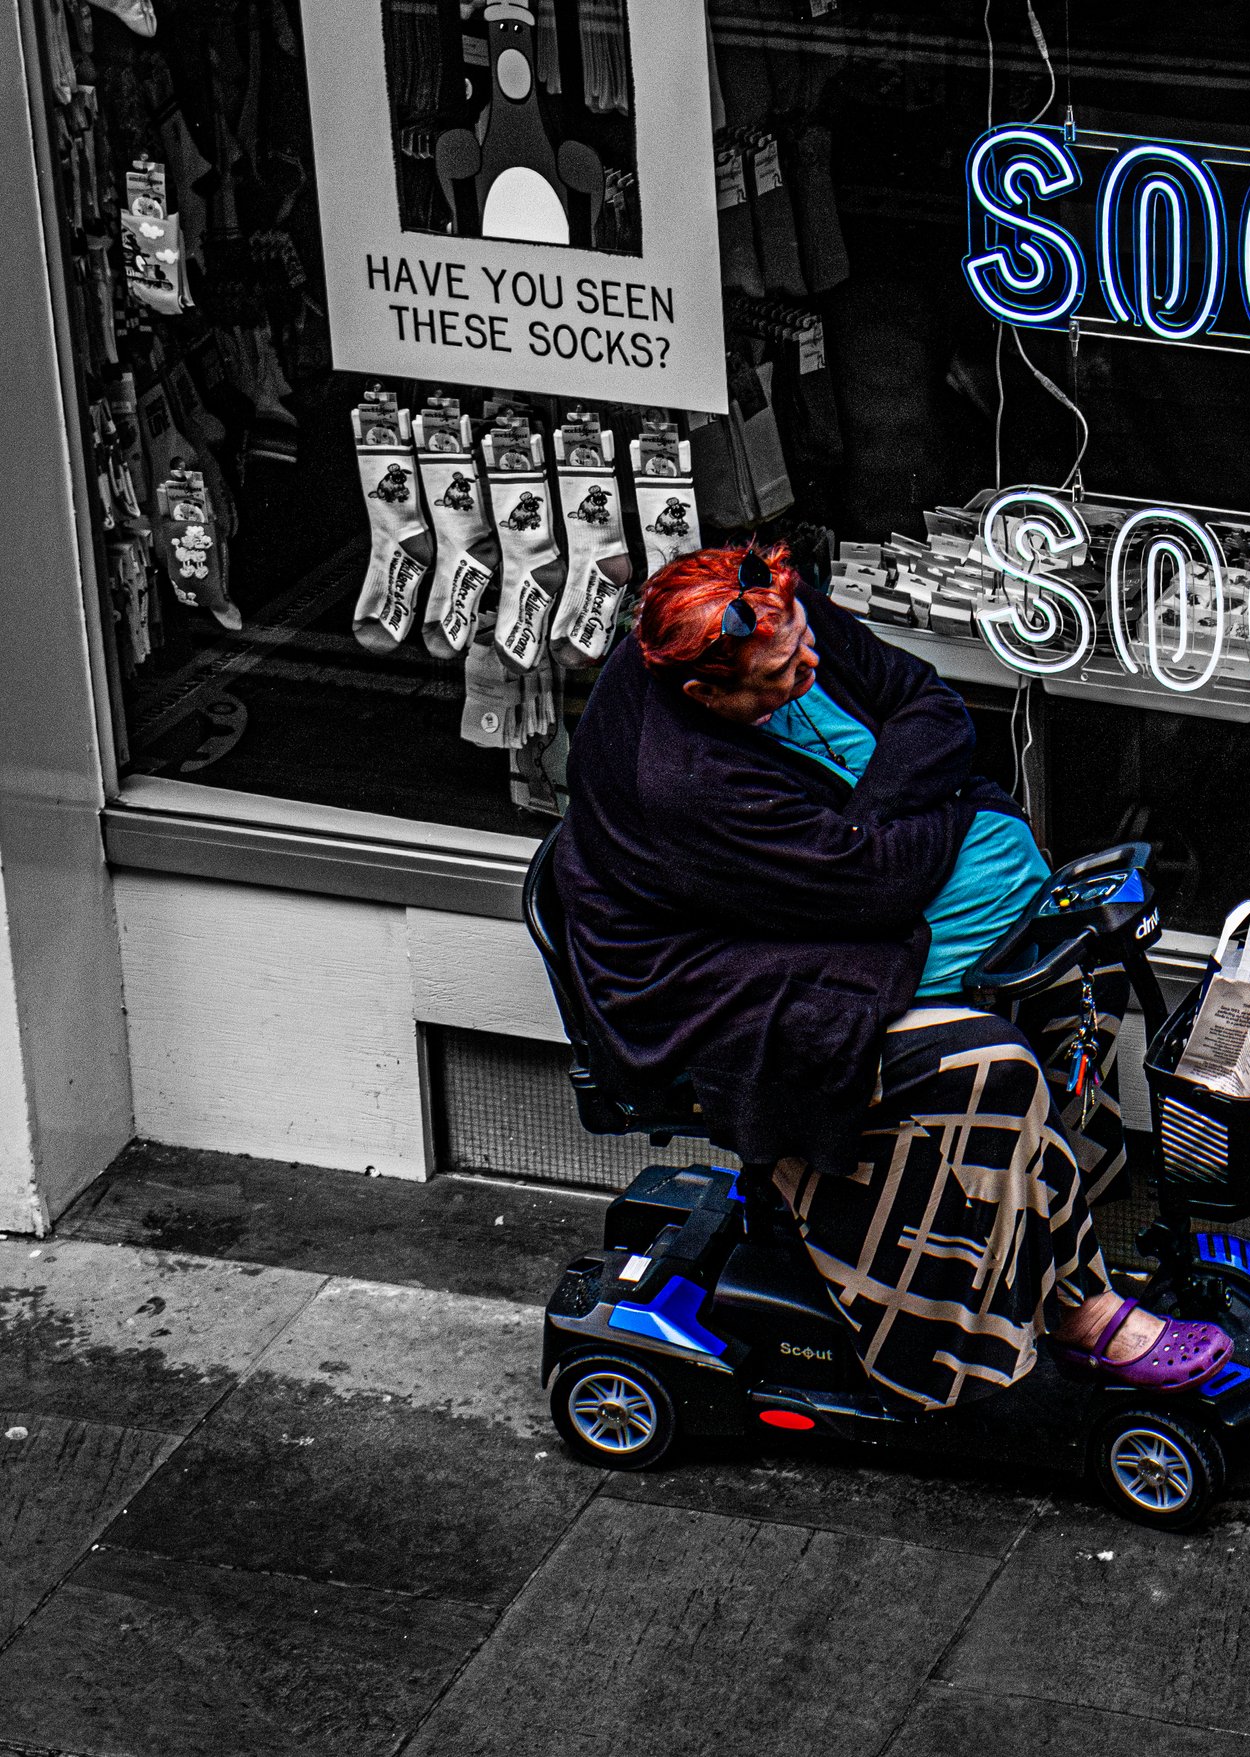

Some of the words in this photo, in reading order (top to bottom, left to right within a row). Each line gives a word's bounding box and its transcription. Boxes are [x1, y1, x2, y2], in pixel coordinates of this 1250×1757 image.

[366, 254, 469, 300] HAVE
[482, 266, 563, 309] YOU
[576, 278, 674, 323] SEEN
[389, 304, 512, 352] THESE
[529, 321, 670, 369] SOCKS?
[780, 1342, 832, 1360] Scout
